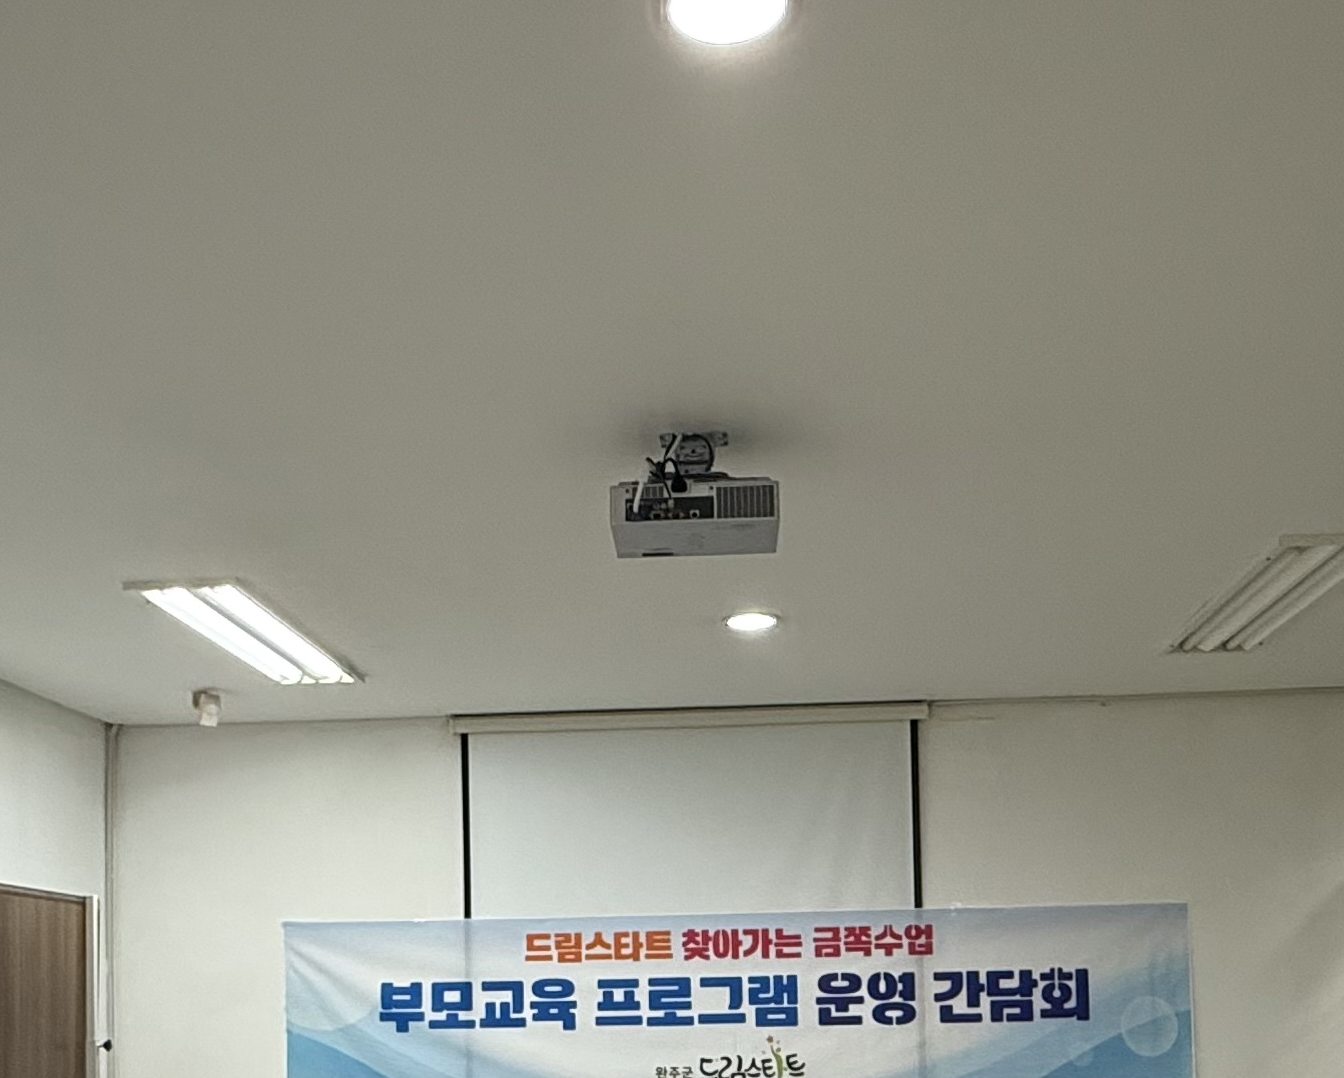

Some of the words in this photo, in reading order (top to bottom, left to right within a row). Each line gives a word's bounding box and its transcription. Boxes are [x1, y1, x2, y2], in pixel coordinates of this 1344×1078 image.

[524, 930, 673, 964] 드림스타트
[681, 927, 803, 961] 찾아가는
[812, 923, 935, 959] 금쪽수업
[377, 978, 578, 1033] 부모교육
[593, 974, 799, 1029] 프로그램
[814, 971, 919, 1026] 운영
[933, 966, 1092, 1024] 간담회
